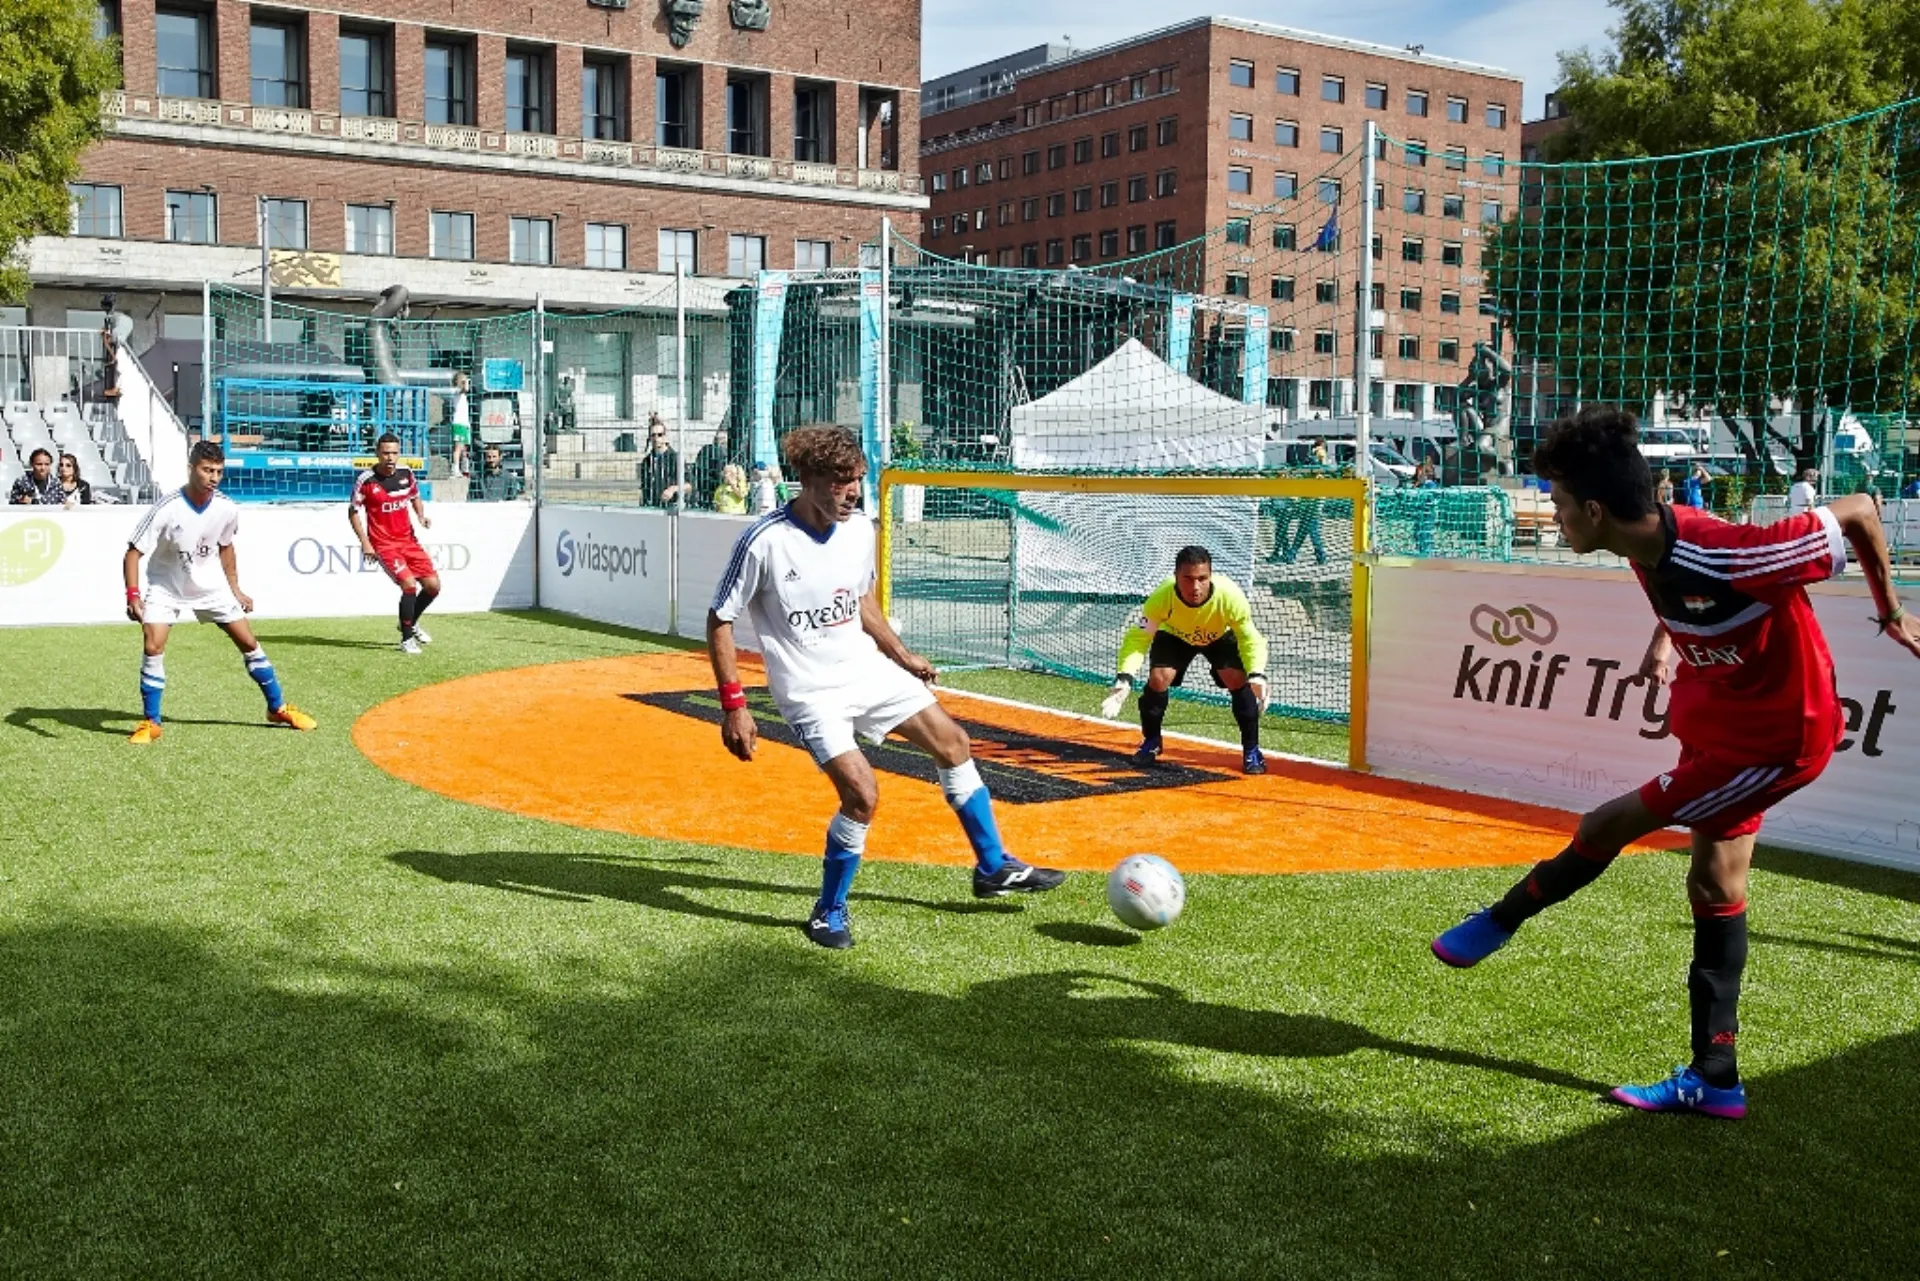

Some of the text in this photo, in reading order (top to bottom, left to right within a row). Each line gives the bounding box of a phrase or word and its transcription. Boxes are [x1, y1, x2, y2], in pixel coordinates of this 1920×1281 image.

[24, 528, 51, 560] PJ
[577, 532, 647, 582] viasport
[1676, 643, 1744, 667] LEAR
[1453, 645, 1897, 757] knif Tryet
